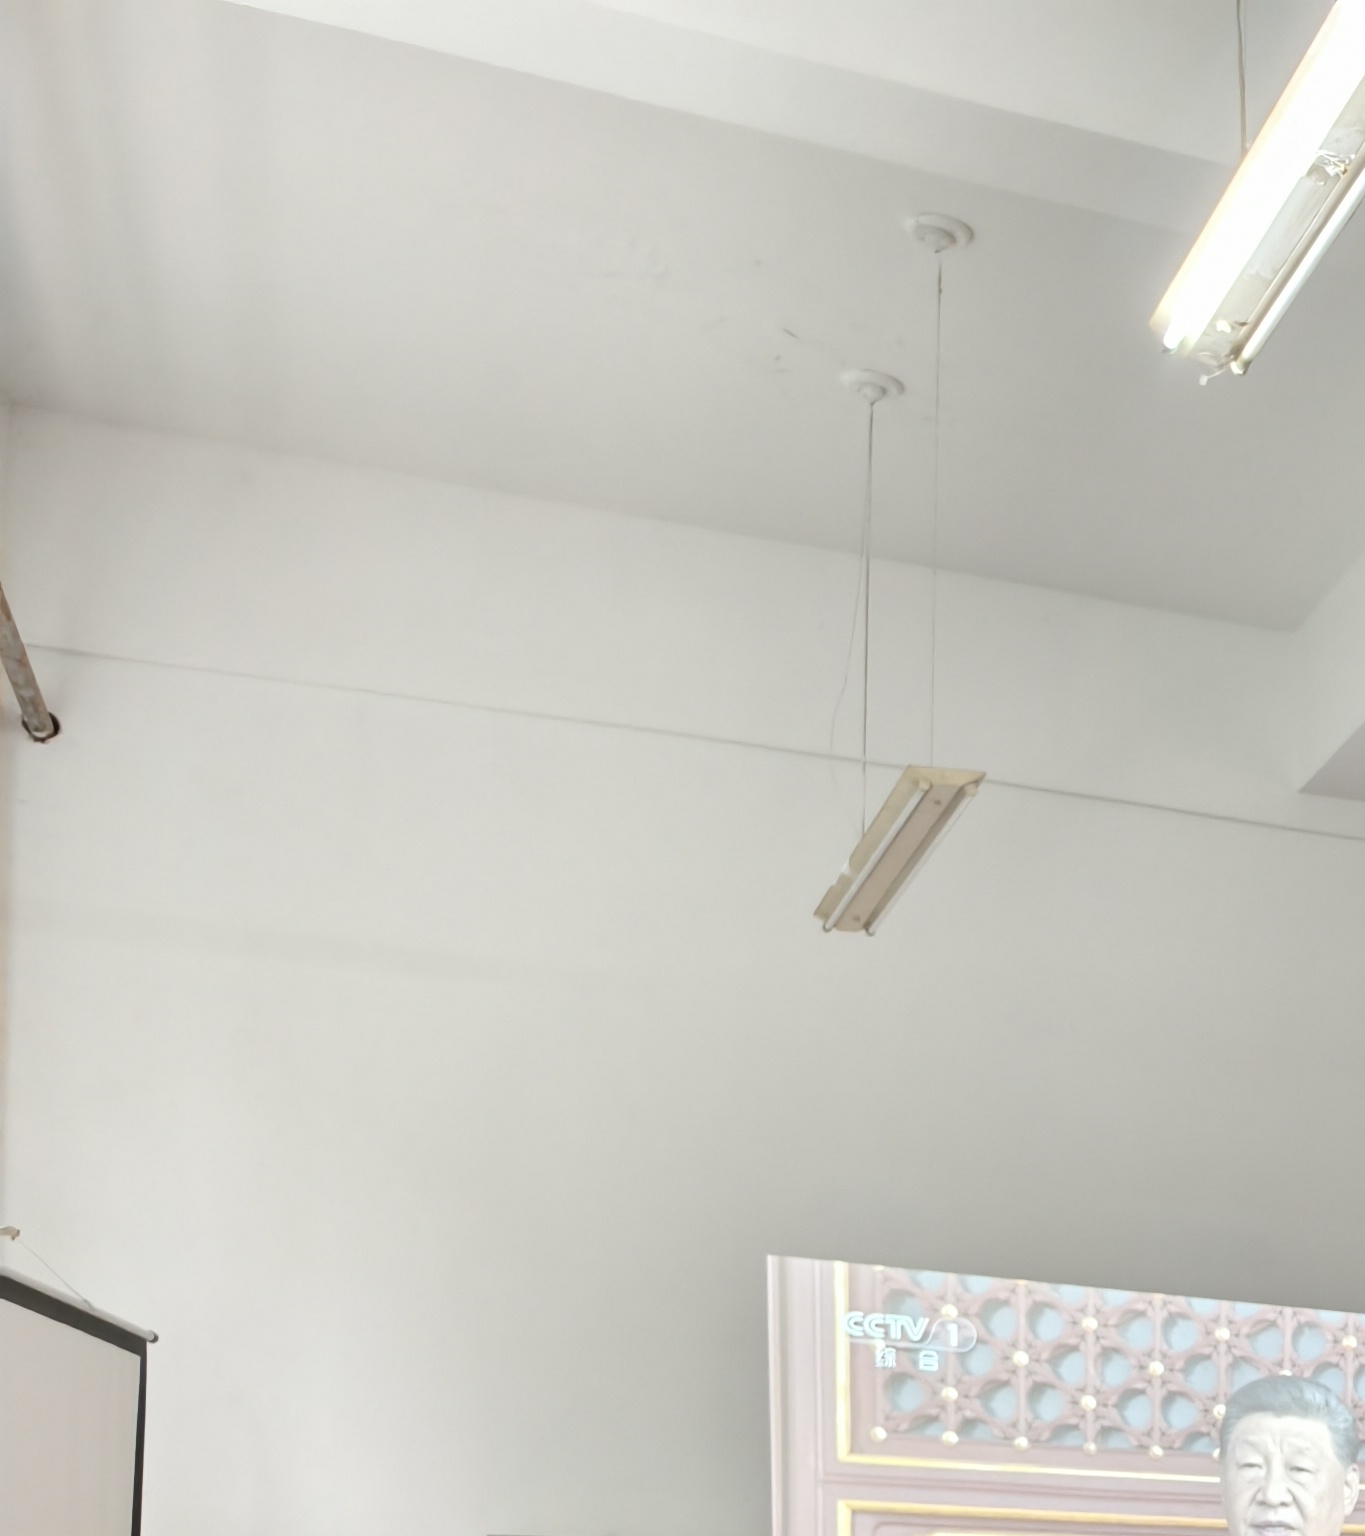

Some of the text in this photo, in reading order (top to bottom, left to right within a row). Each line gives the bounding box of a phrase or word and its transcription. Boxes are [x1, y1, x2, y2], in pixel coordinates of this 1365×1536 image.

[842, 1310, 959, 1347] CCTV 1
[875, 1347, 939, 1372] 综合
